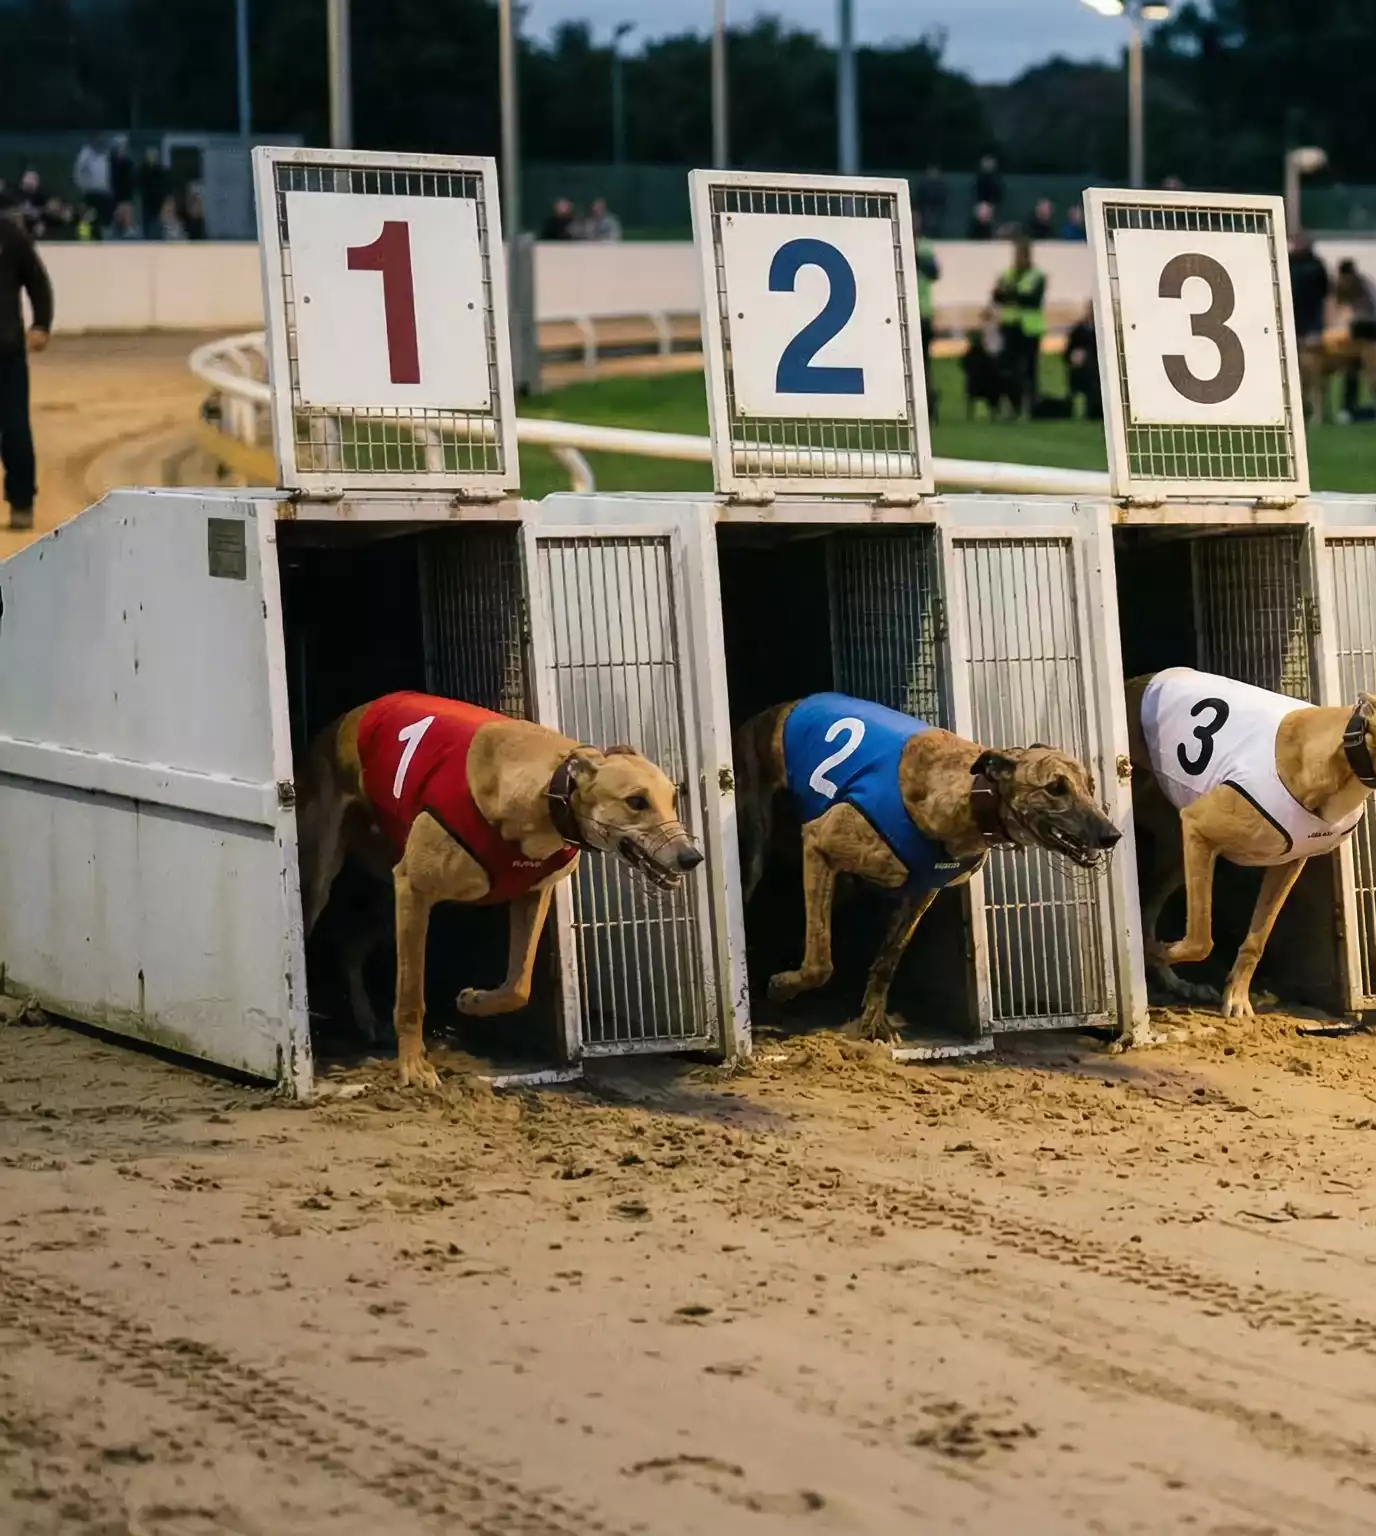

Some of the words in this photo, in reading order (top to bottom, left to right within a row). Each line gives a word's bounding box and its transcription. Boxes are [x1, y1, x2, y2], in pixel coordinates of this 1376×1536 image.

[347, 220, 421, 385] 1
[768, 238, 865, 395] 2
[1158, 253, 1245, 405] 3
[393, 715, 435, 799] 1
[809, 717, 866, 799] 2
[1177, 698, 1230, 776] 3
